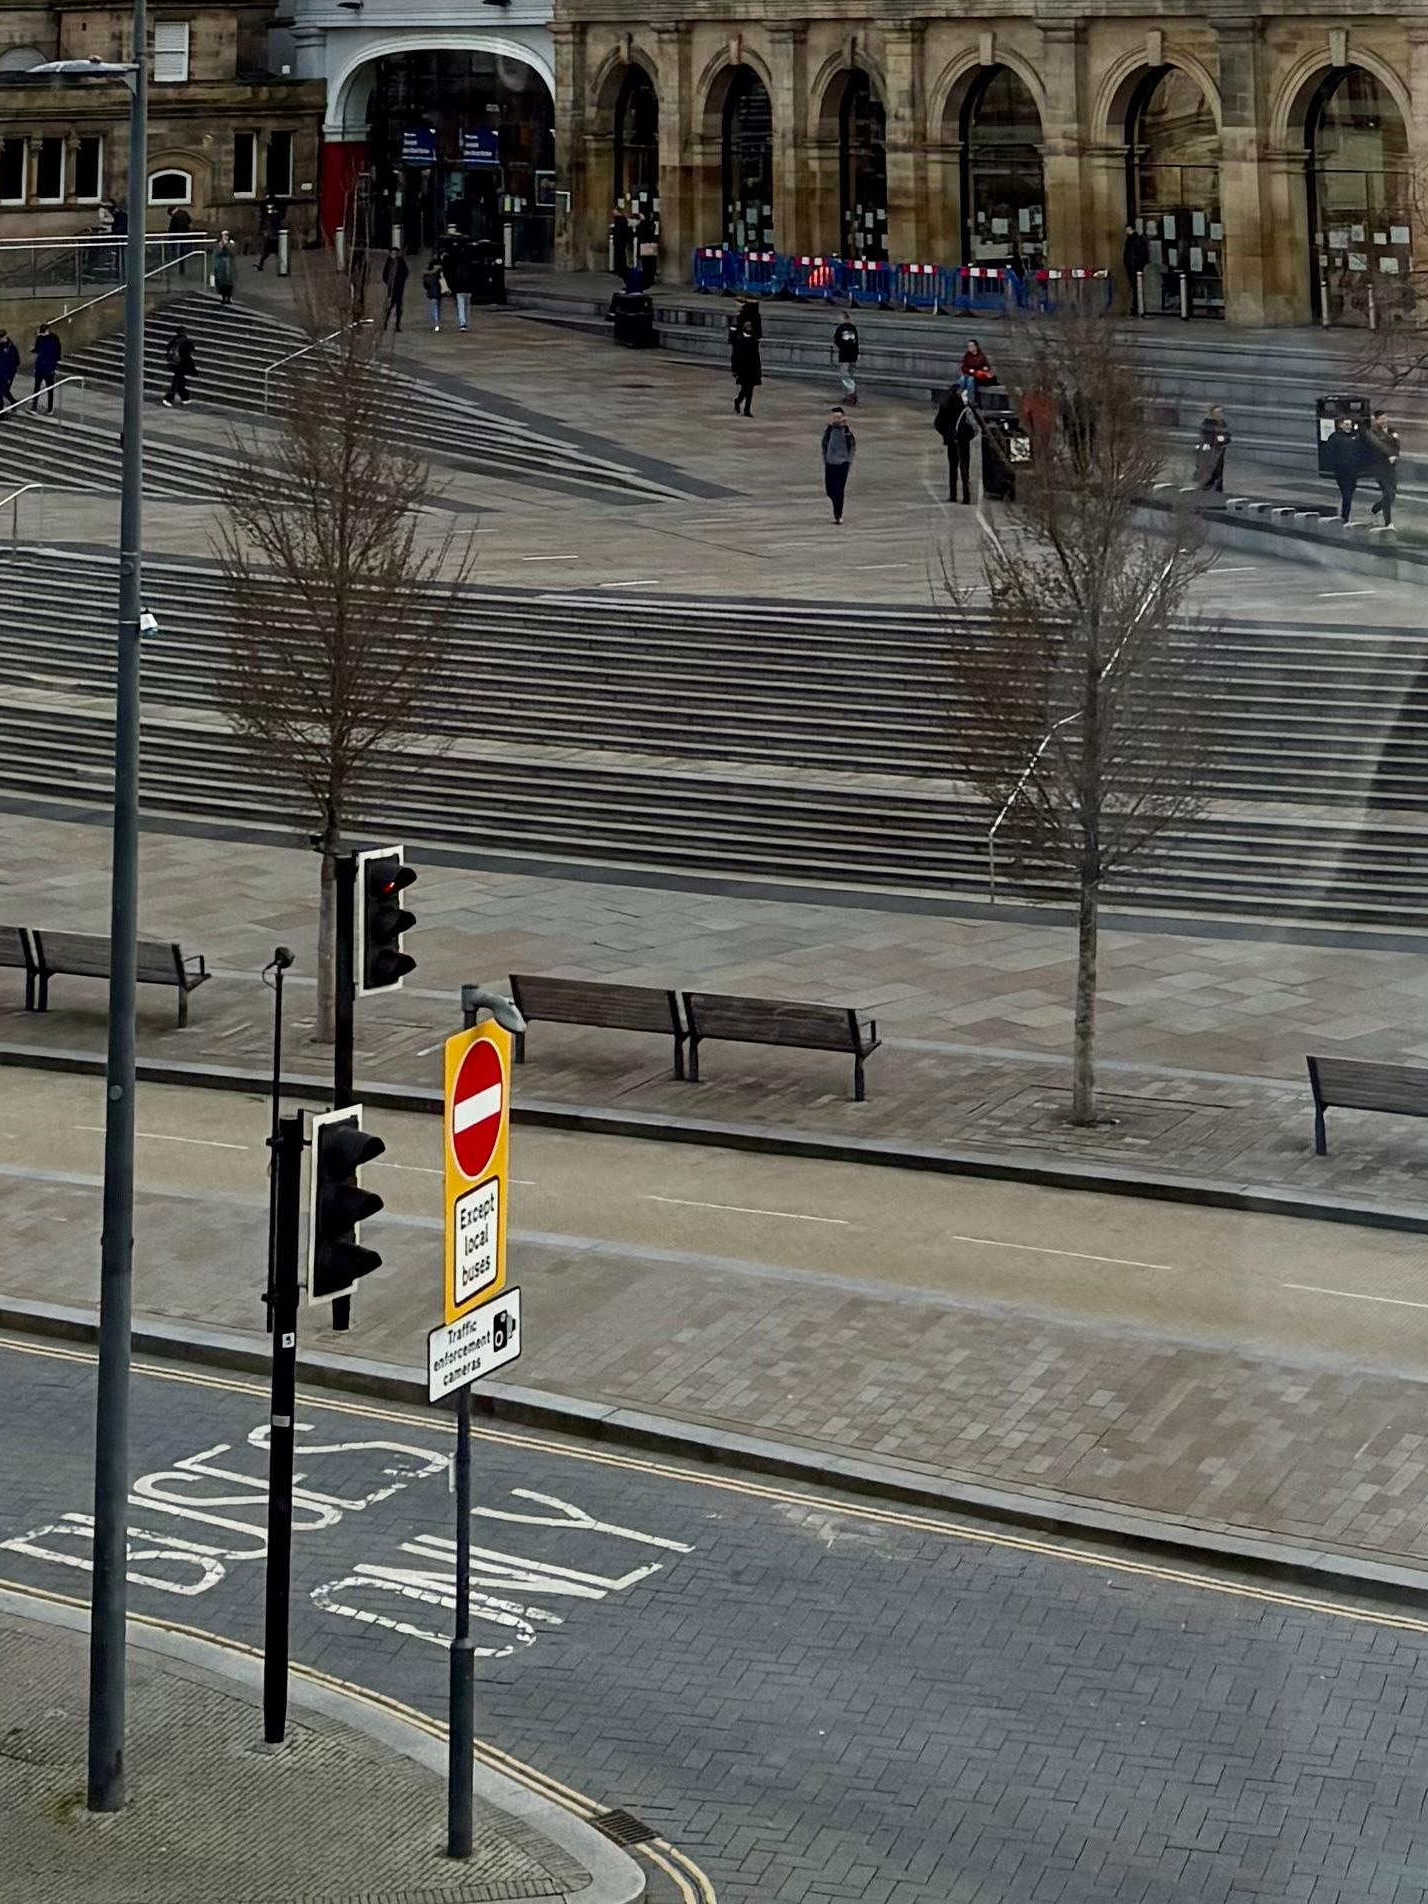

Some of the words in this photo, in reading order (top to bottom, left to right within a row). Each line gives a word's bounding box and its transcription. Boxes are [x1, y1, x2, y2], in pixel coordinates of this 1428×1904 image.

[460, 1193, 495, 1231] Except
[465, 1223, 489, 1256] local
[462, 1256, 491, 1286] buses
[447, 1319, 477, 1345] Traffic
[433, 1330, 491, 1372] enforcement
[443, 1357, 482, 1386] cameras
[310, 1488, 695, 1657] ONLY
